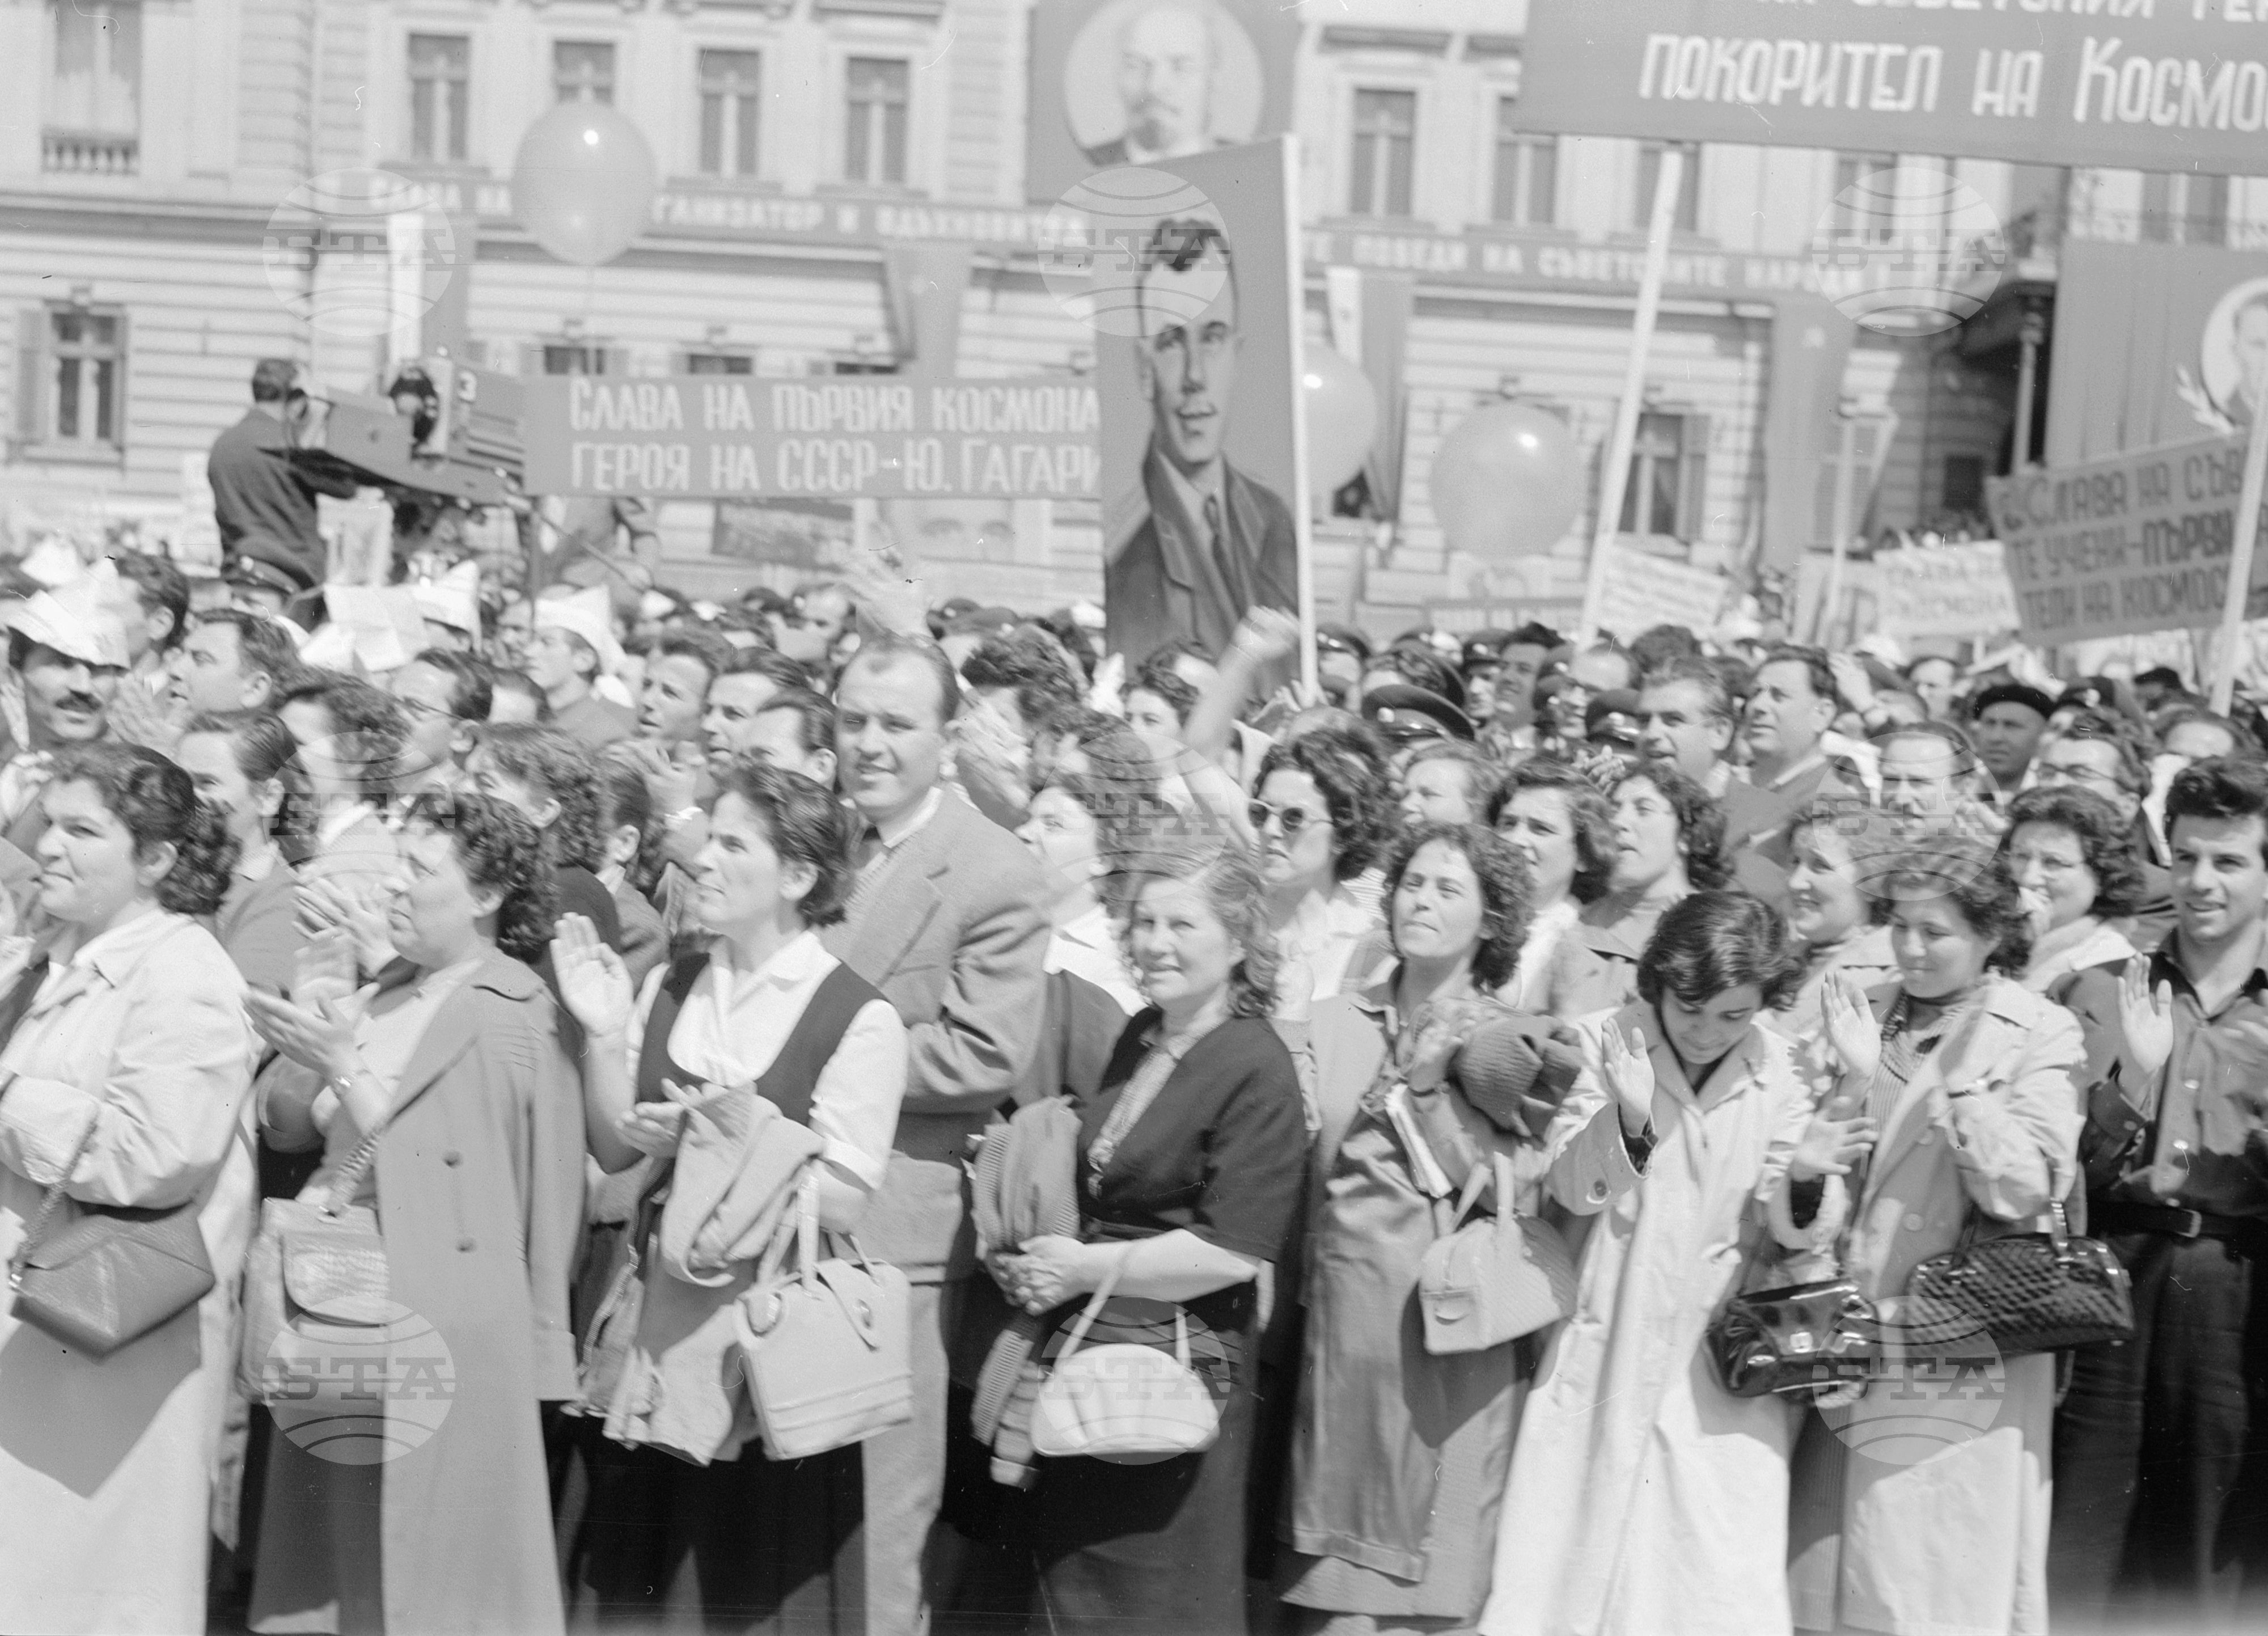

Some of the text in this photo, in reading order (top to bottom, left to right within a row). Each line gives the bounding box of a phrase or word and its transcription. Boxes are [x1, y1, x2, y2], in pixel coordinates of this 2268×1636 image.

[1639, 33, 2268, 132] ПОКОРИТЕЛ НА КОСМО
[569, 377, 684, 432] СЛАВА
[703, 383, 755, 432] НА
[772, 383, 914, 432] ПЪРВИЯ
[571, 441, 690, 491] ГЕРОЯ
[710, 443, 760, 491] НА
[2183, 445, 2249, 503] СЪВ
